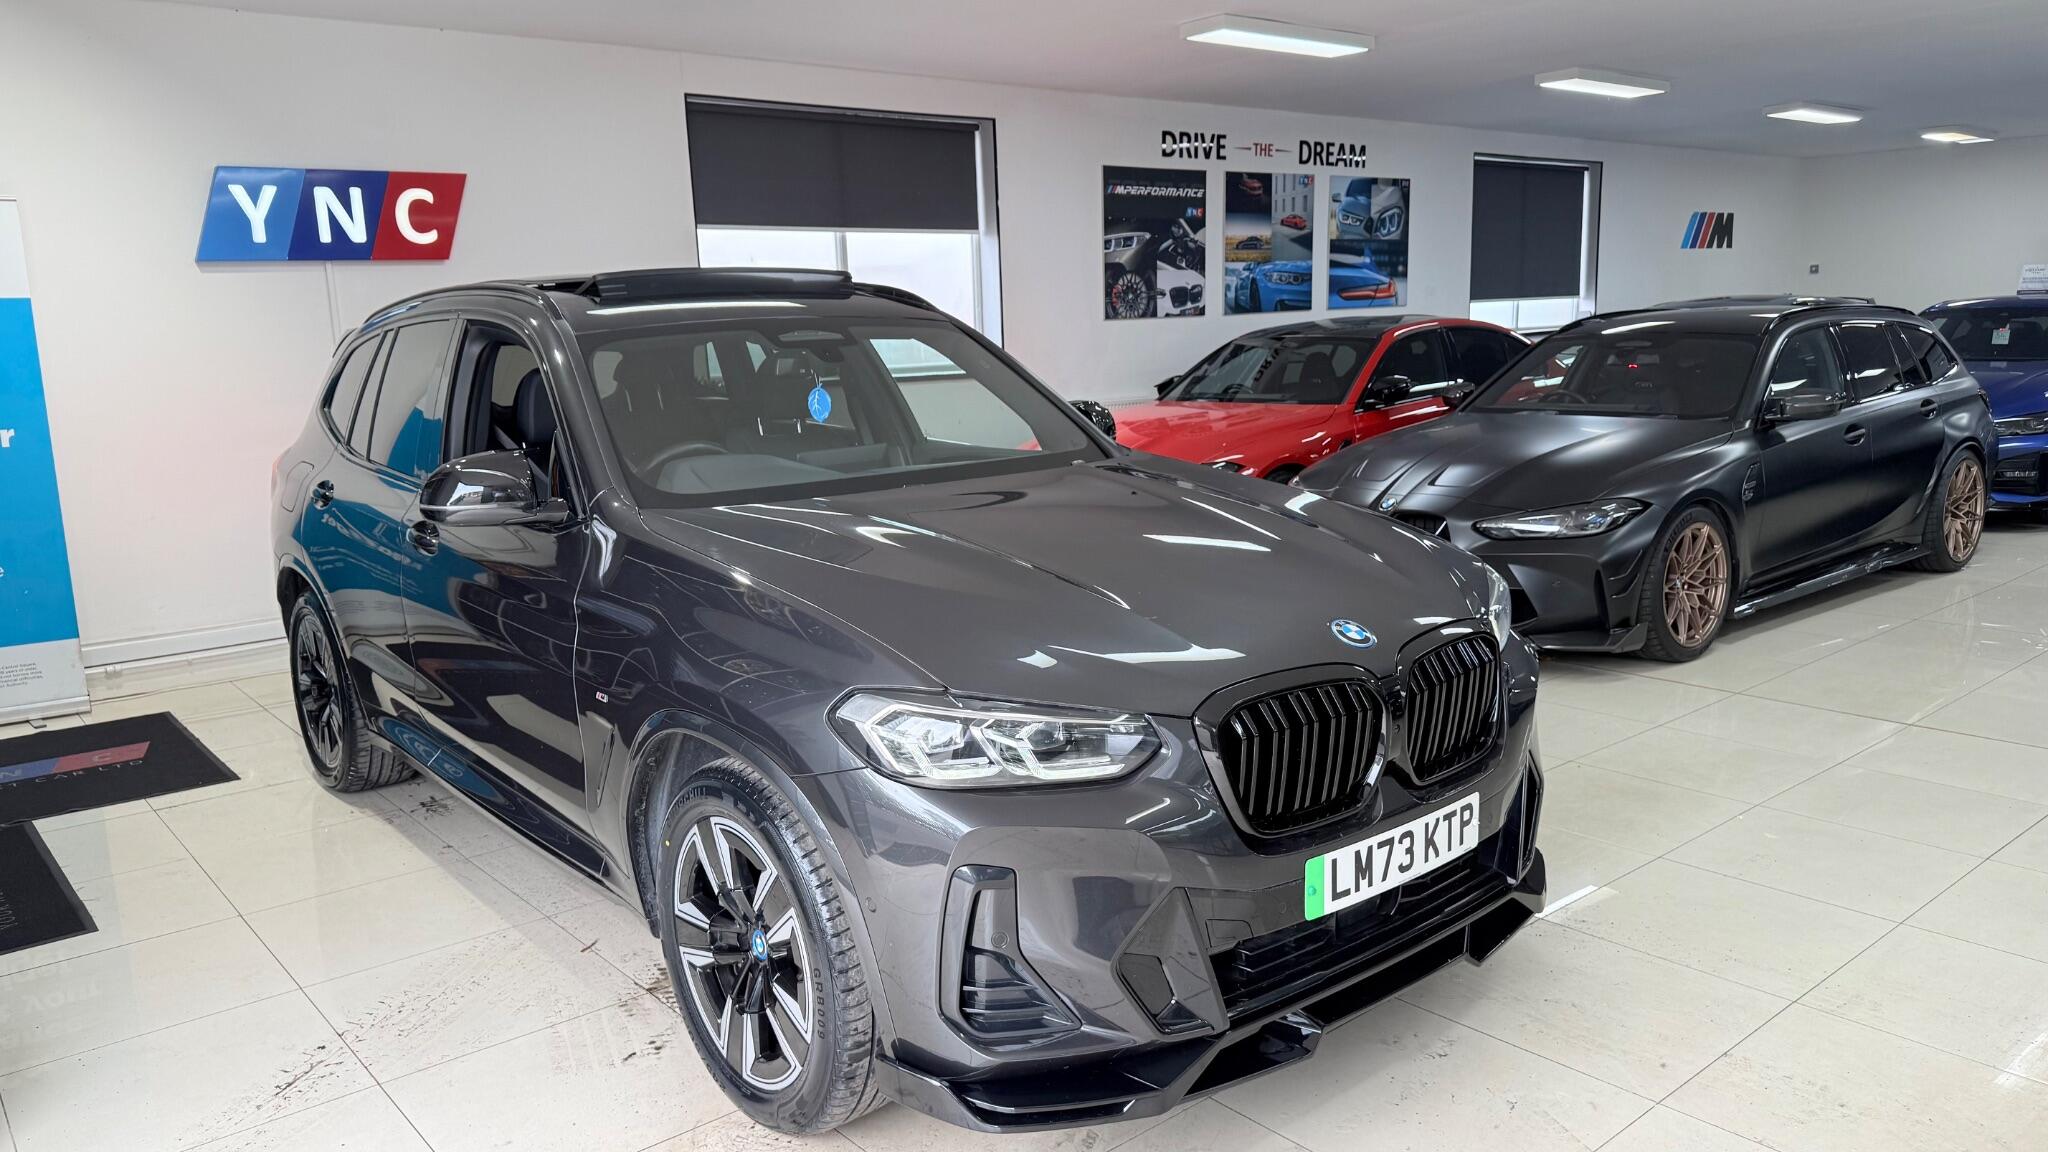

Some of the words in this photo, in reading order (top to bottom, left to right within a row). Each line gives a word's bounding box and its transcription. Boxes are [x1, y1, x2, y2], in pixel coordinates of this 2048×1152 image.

[1161, 130, 1227, 160] DRIVE
[1253, 142, 1274, 157] THE
[1298, 140, 1366, 168] DREAM
[228, 184, 438, 244] YNC
[1331, 829, 1415, 902] LM73
[1424, 802, 1474, 864] KTP
